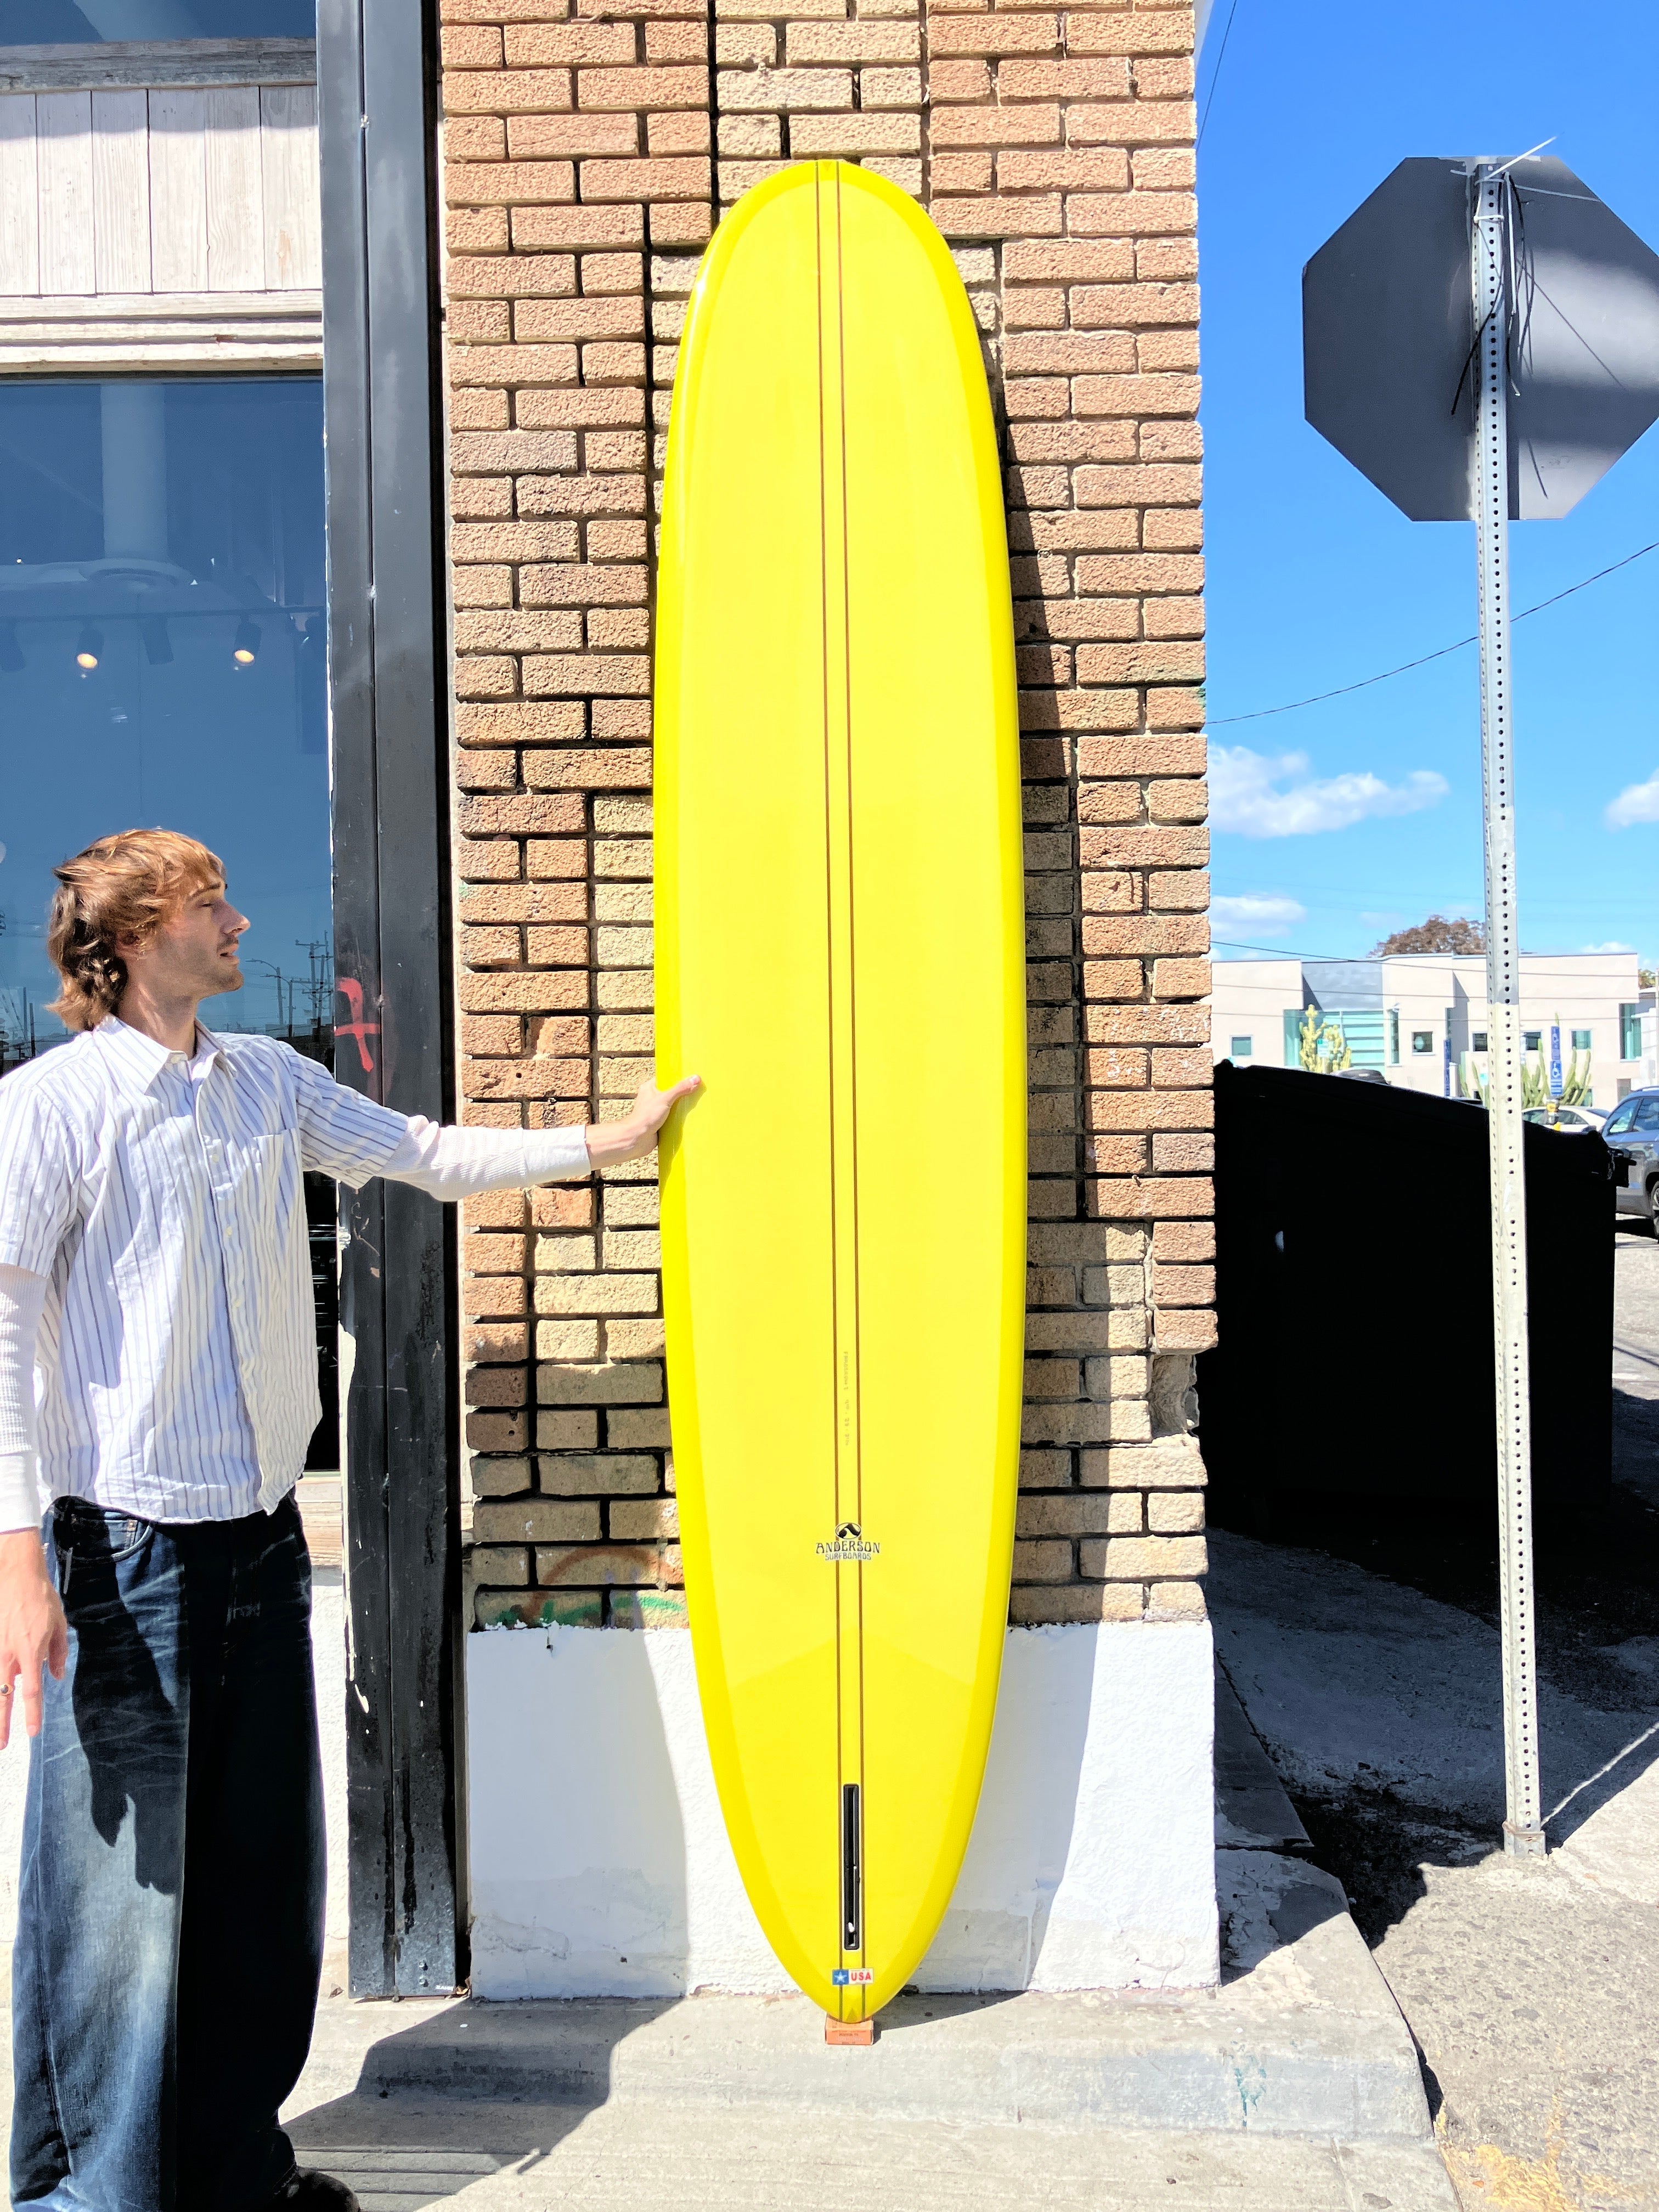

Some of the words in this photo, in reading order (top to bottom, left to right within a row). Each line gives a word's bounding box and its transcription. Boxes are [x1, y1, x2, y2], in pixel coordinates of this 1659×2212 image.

[816, 1541, 880, 1554] ANDERSON
[825, 1552, 871, 1561] SURFBOARDS
[851, 1972, 871, 1981] USA
